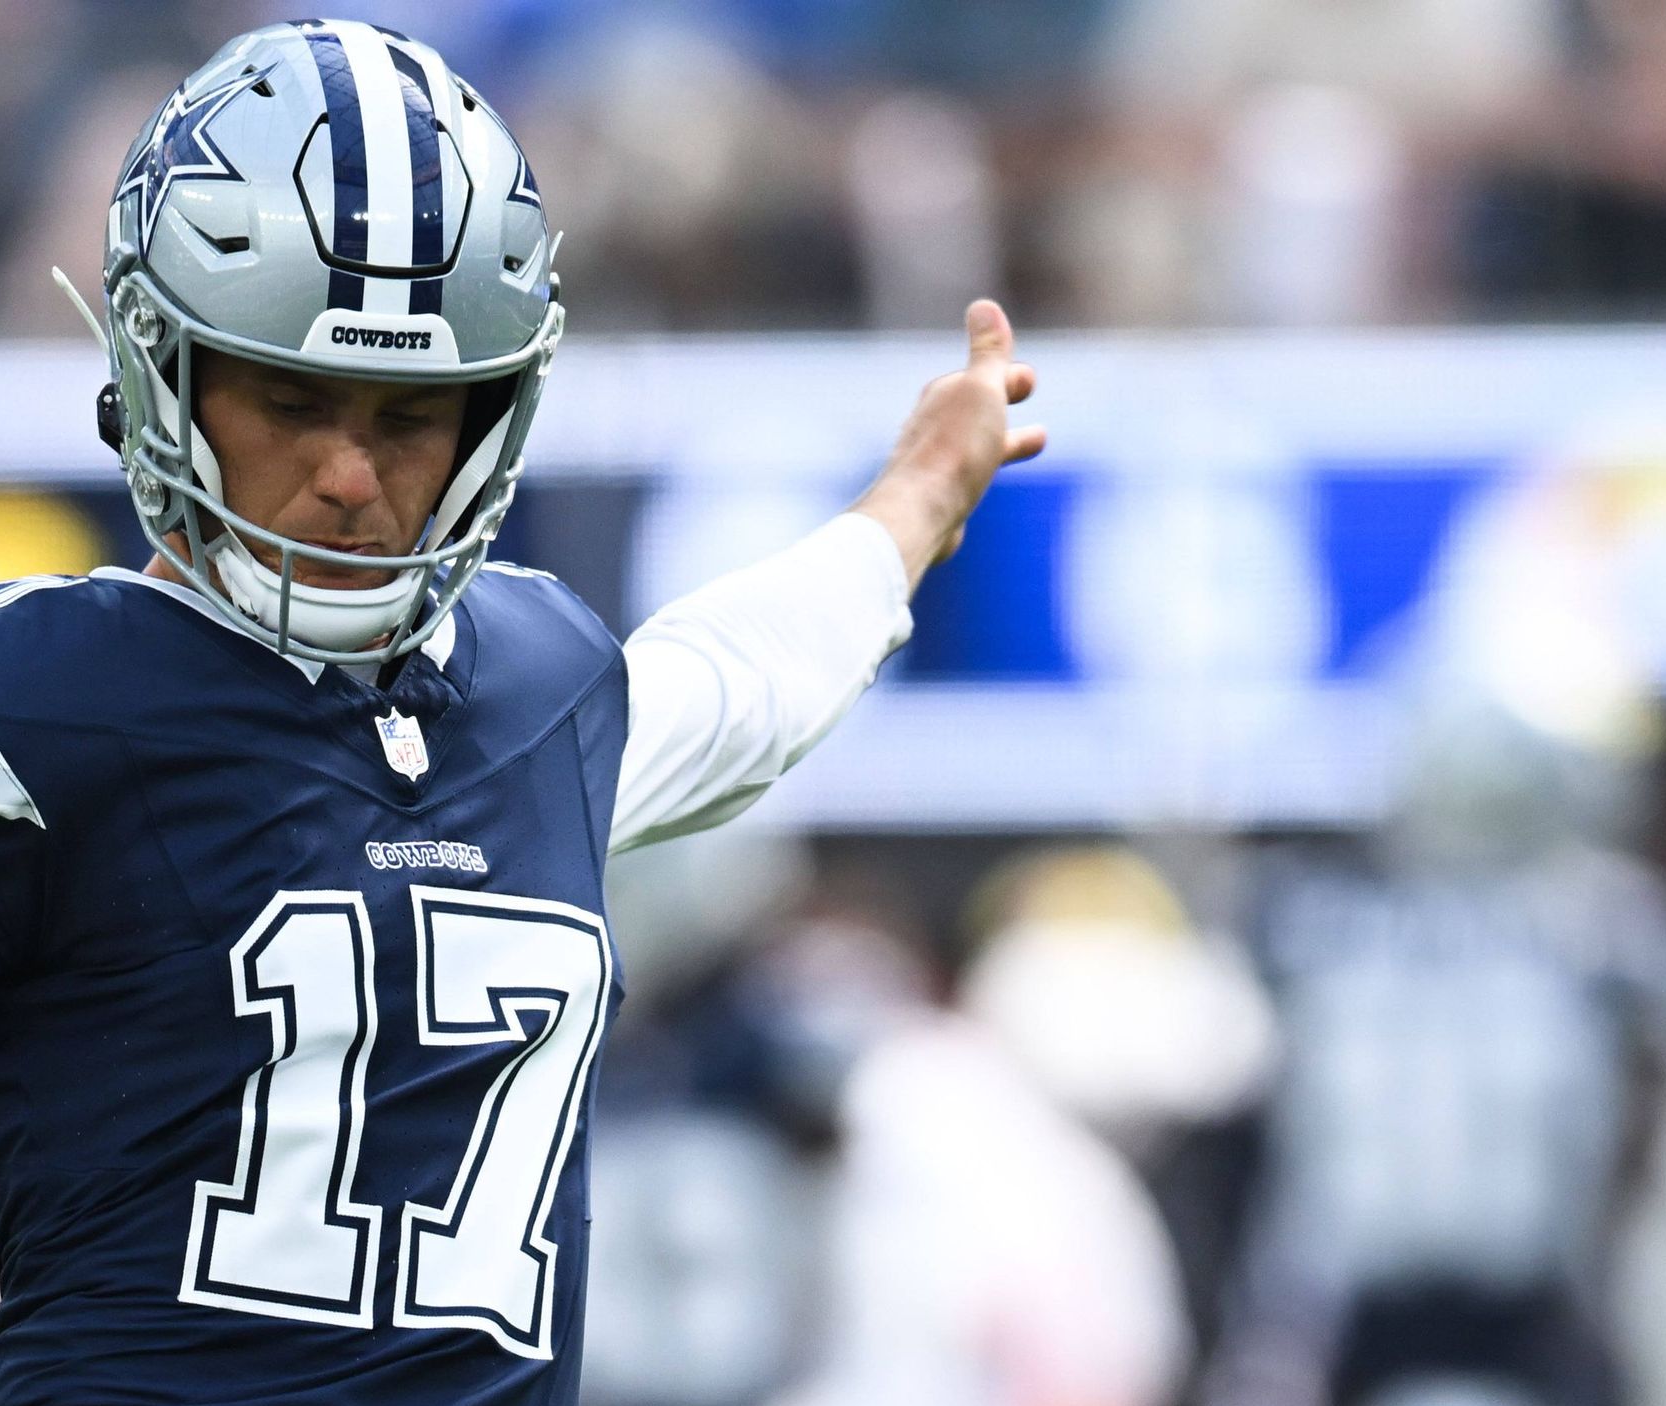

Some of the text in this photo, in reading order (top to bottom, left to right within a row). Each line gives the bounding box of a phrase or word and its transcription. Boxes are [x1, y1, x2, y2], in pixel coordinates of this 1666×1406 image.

[331, 326, 432, 350] COWBOYS
[365, 841, 488, 873] COWBOYS
[177, 884, 613, 1361] 17
